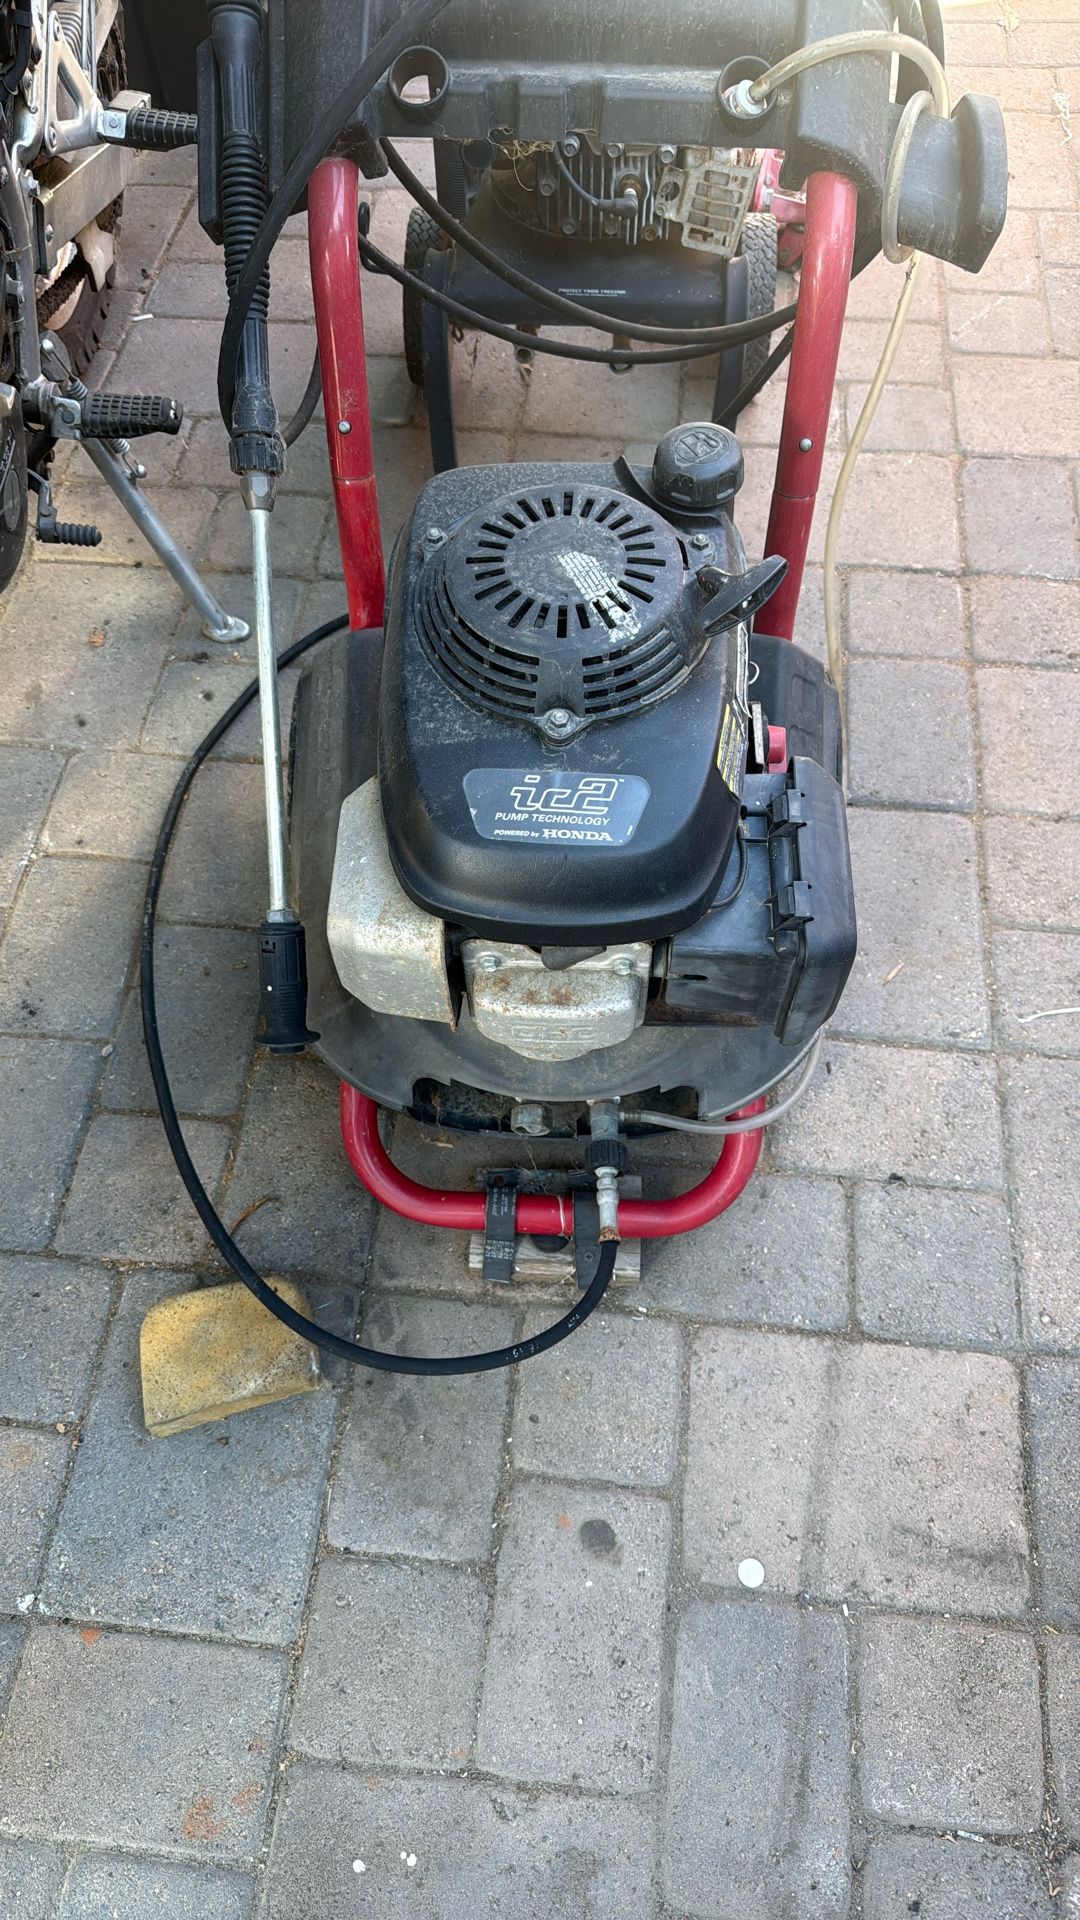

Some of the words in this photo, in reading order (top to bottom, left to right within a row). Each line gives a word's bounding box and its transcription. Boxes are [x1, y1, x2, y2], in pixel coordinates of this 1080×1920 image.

[494, 812, 529, 822] PUMP
[532, 813, 611, 826] TECHNOLOGY
[493, 829, 529, 837] POWERED
[530, 830, 540, 838] by
[542, 828, 613, 842] HONDA
